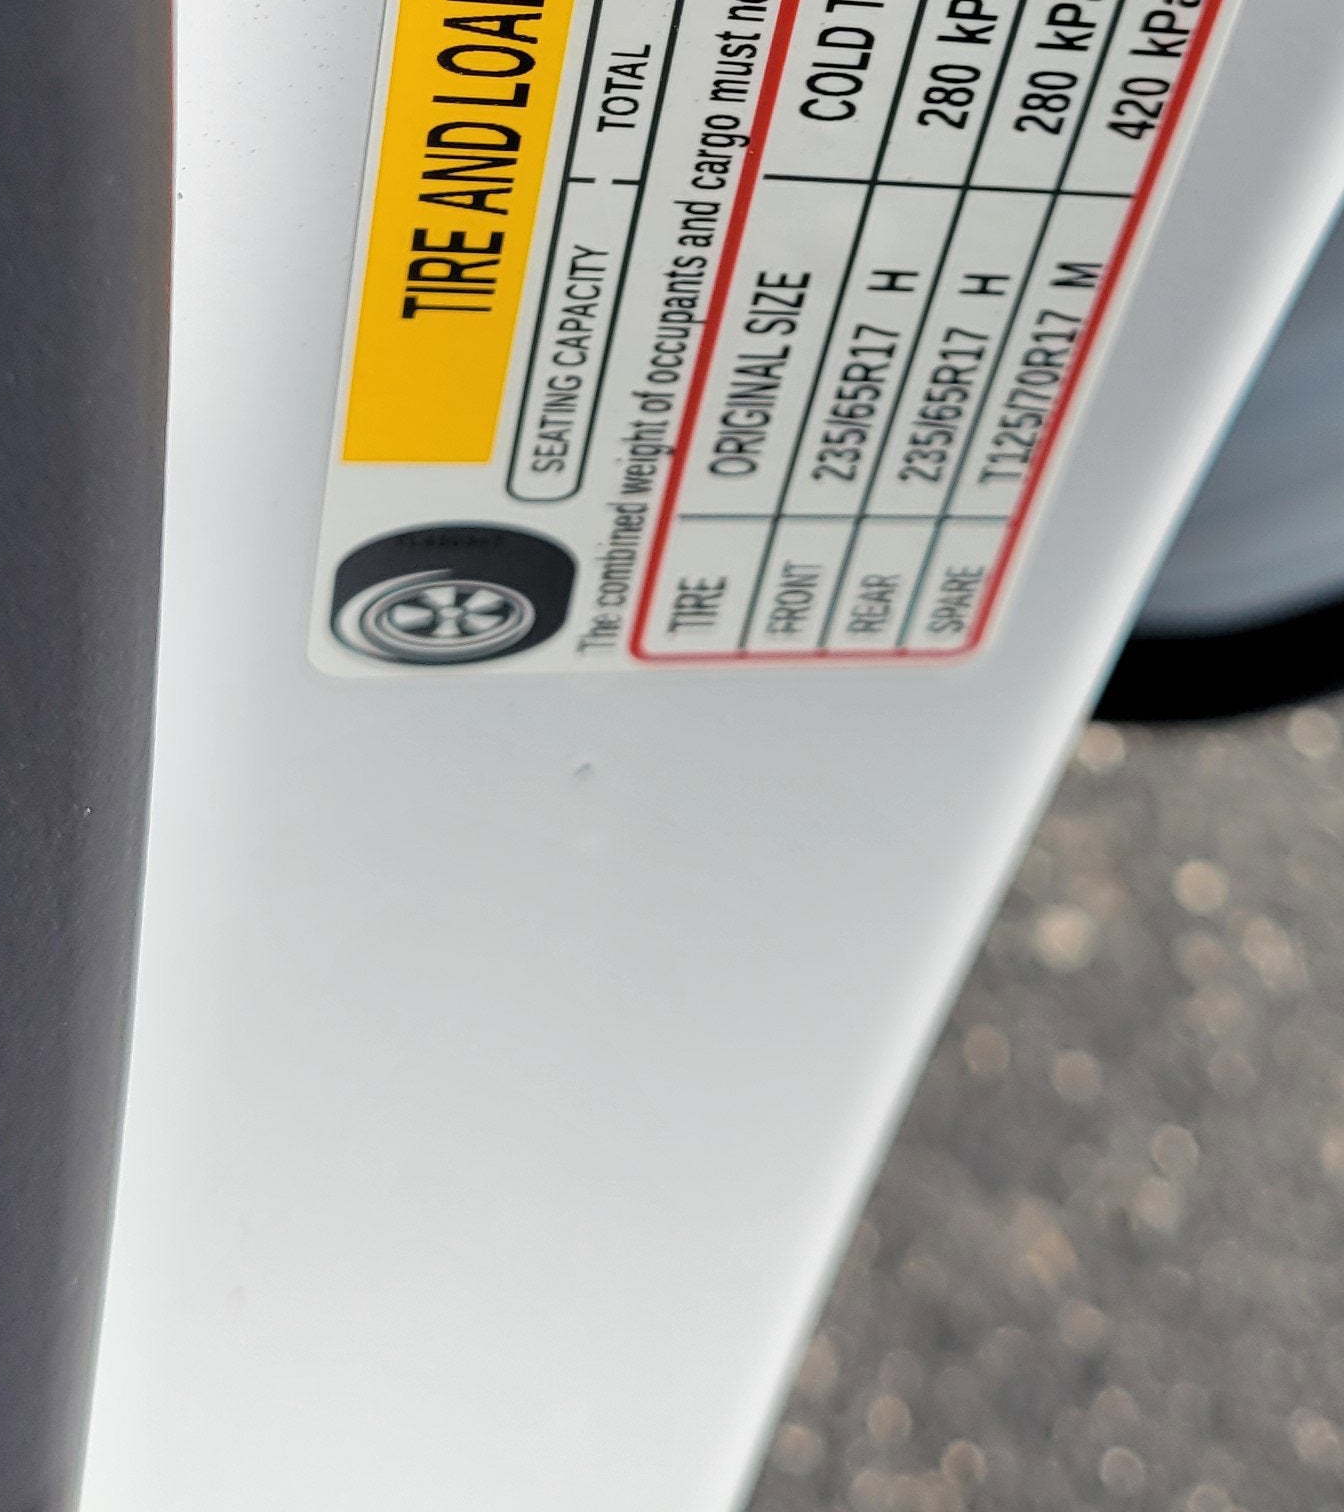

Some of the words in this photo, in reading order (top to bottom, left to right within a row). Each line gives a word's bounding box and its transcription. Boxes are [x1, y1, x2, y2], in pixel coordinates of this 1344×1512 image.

[596, 44, 651, 132] TOTAL
[709, 30, 762, 103] must
[799, 25, 876, 122] COLD
[419, 121, 522, 215] AND
[691, 114, 750, 191] cargo
[673, 200, 722, 248] and
[402, 228, 505, 318] TIRE
[553, 244, 609, 368] CAPACITY
[745, 270, 811, 337] SIZE
[648, 255, 707, 384] occupants
[766, 560, 823, 636] FRONT
[811, 323, 901, 483] 235/65R17
[866, 268, 920, 292] H
[917, 64, 981, 130] 280
[846, 574, 900, 635] REAR
[897, 326, 990, 484] 235/65R17
[958, 273, 1012, 296] H
[1013, 71, 1078, 135] 280
[927, 565, 985, 636] SPARE
[977, 309, 1084, 486] T125/70R17
[1050, 261, 1104, 289] M
[1106, 77, 1170, 140] 420
[532, 375, 583, 474] SEATING
[633, 391, 674, 414] of
[708, 344, 791, 478] ORIGINAL
[615, 420, 675, 495] weight
[595, 503, 650, 610] combined
[577, 612, 622, 656] The
[669, 576, 728, 636] TIRE
